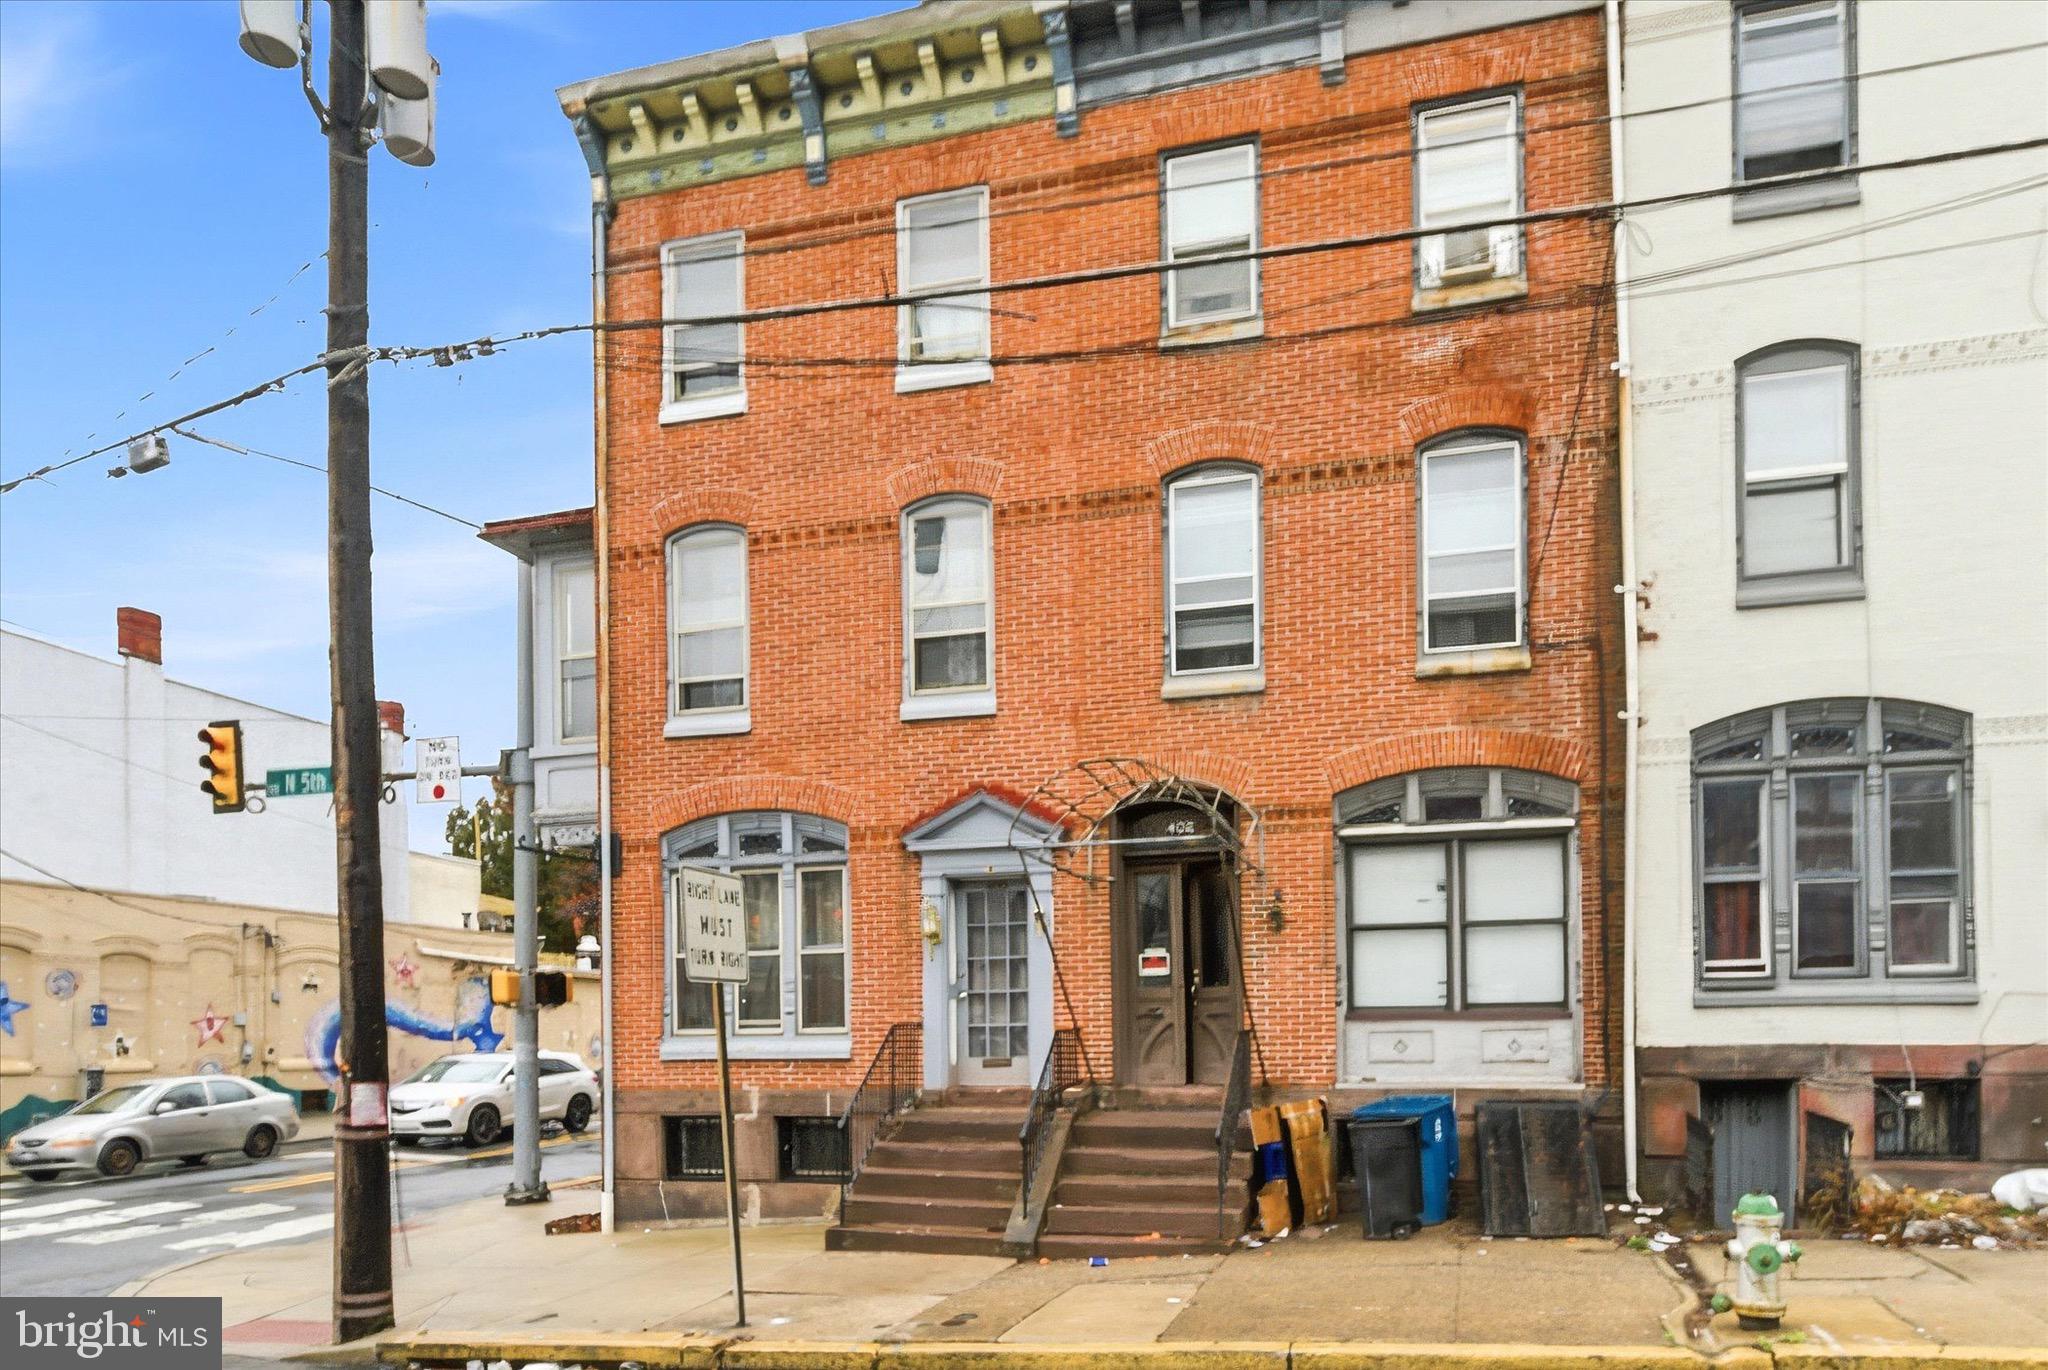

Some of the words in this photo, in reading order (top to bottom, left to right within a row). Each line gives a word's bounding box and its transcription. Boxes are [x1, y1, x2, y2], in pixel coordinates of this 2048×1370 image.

[285, 773, 295, 793] N
[301, 771, 327, 793] 5th
[687, 881, 715, 900] RIGHT
[718, 888, 741, 907] LANE
[699, 915, 732, 938] MUST
[690, 948, 715, 966] TURN
[721, 951, 745, 968] RIGHT
